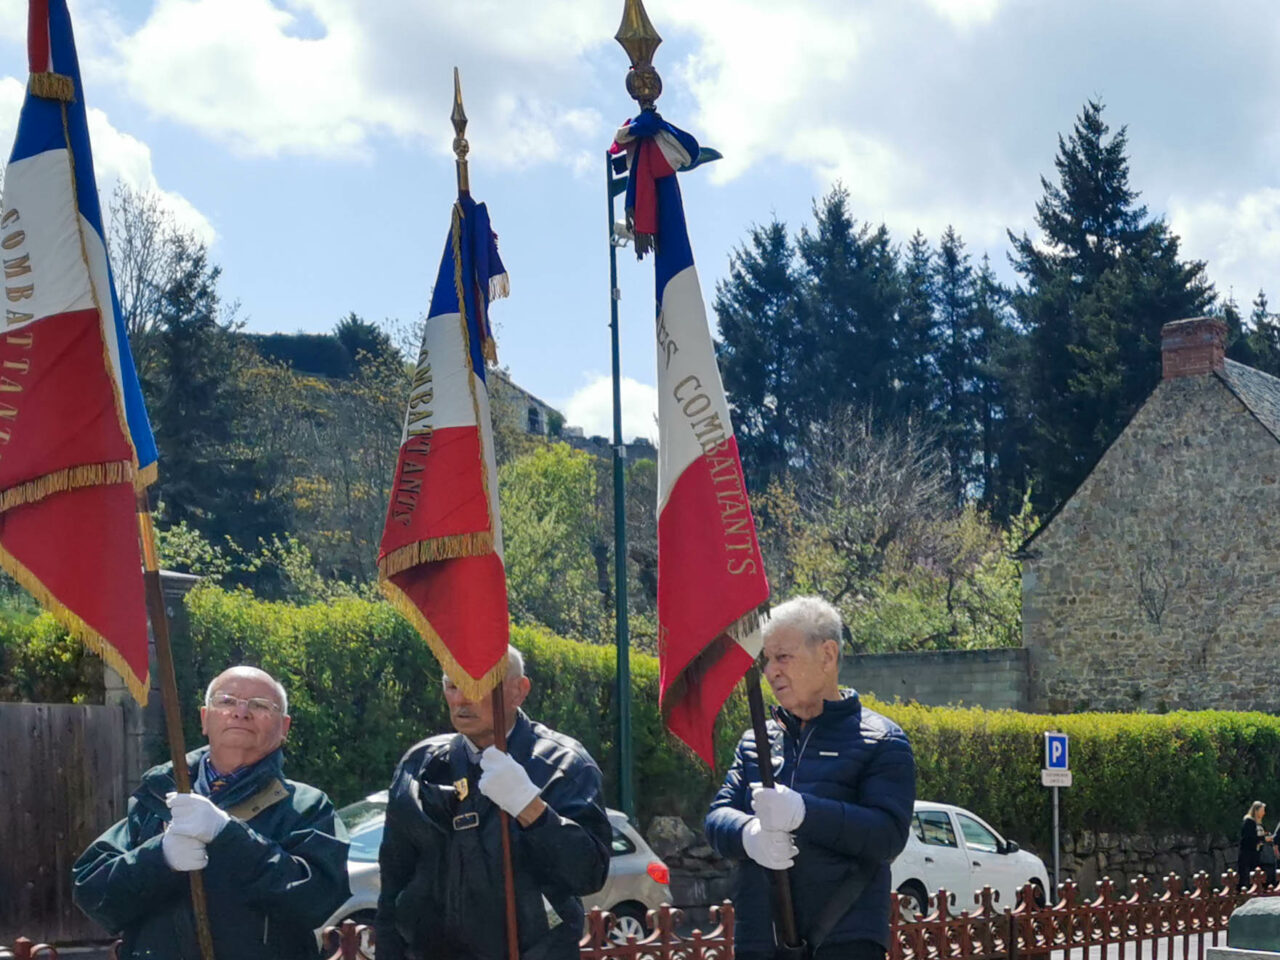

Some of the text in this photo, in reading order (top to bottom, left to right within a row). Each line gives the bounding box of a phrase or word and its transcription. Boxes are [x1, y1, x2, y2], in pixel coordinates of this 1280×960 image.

[0, 208, 34, 460] COMBATTAN
[391, 338, 434, 526] OMBATTANTS
[673, 375, 757, 575] COMBATTANTS
[1052, 741, 1062, 763] P
